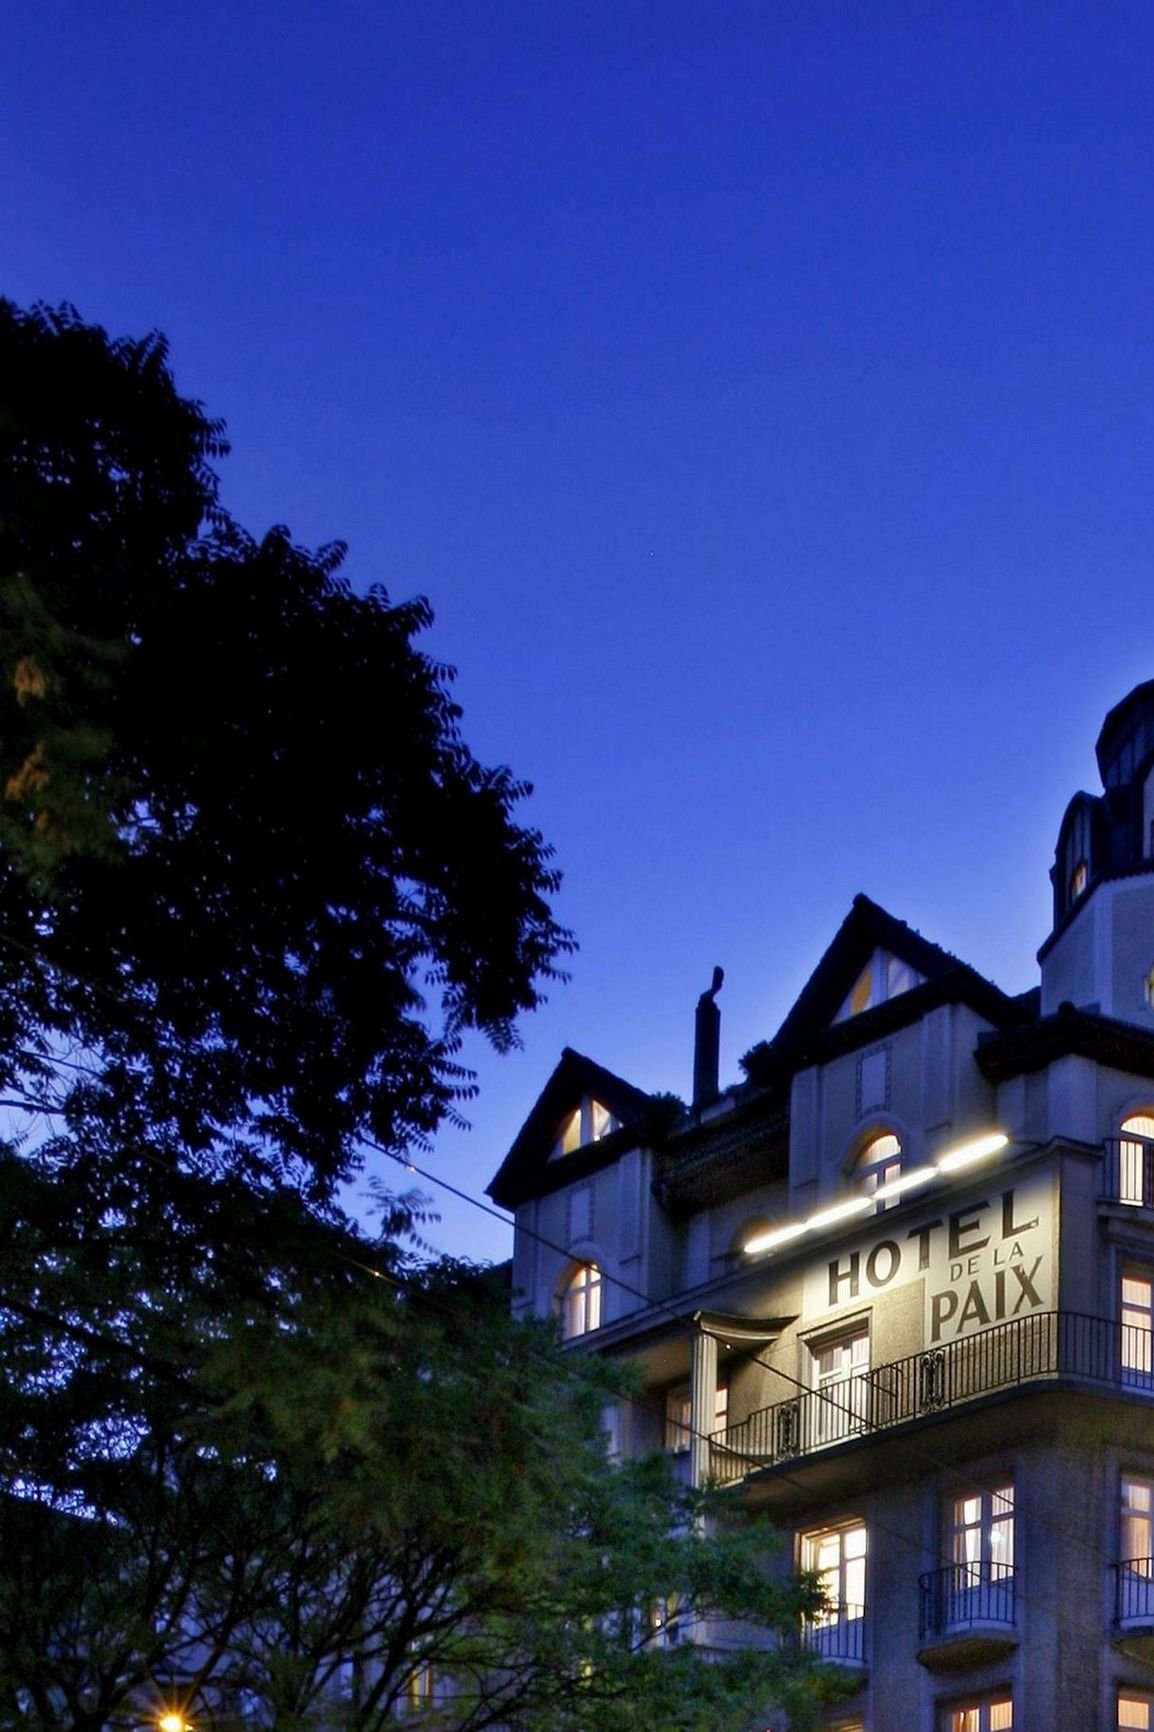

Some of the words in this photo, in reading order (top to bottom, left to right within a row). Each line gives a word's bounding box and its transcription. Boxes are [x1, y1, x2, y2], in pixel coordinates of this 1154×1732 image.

[828, 1189, 1039, 1306] HOTEL
[950, 1254, 981, 1282] DE
[993, 1241, 1024, 1266] LA
[931, 1255, 1044, 1343] PAIX
